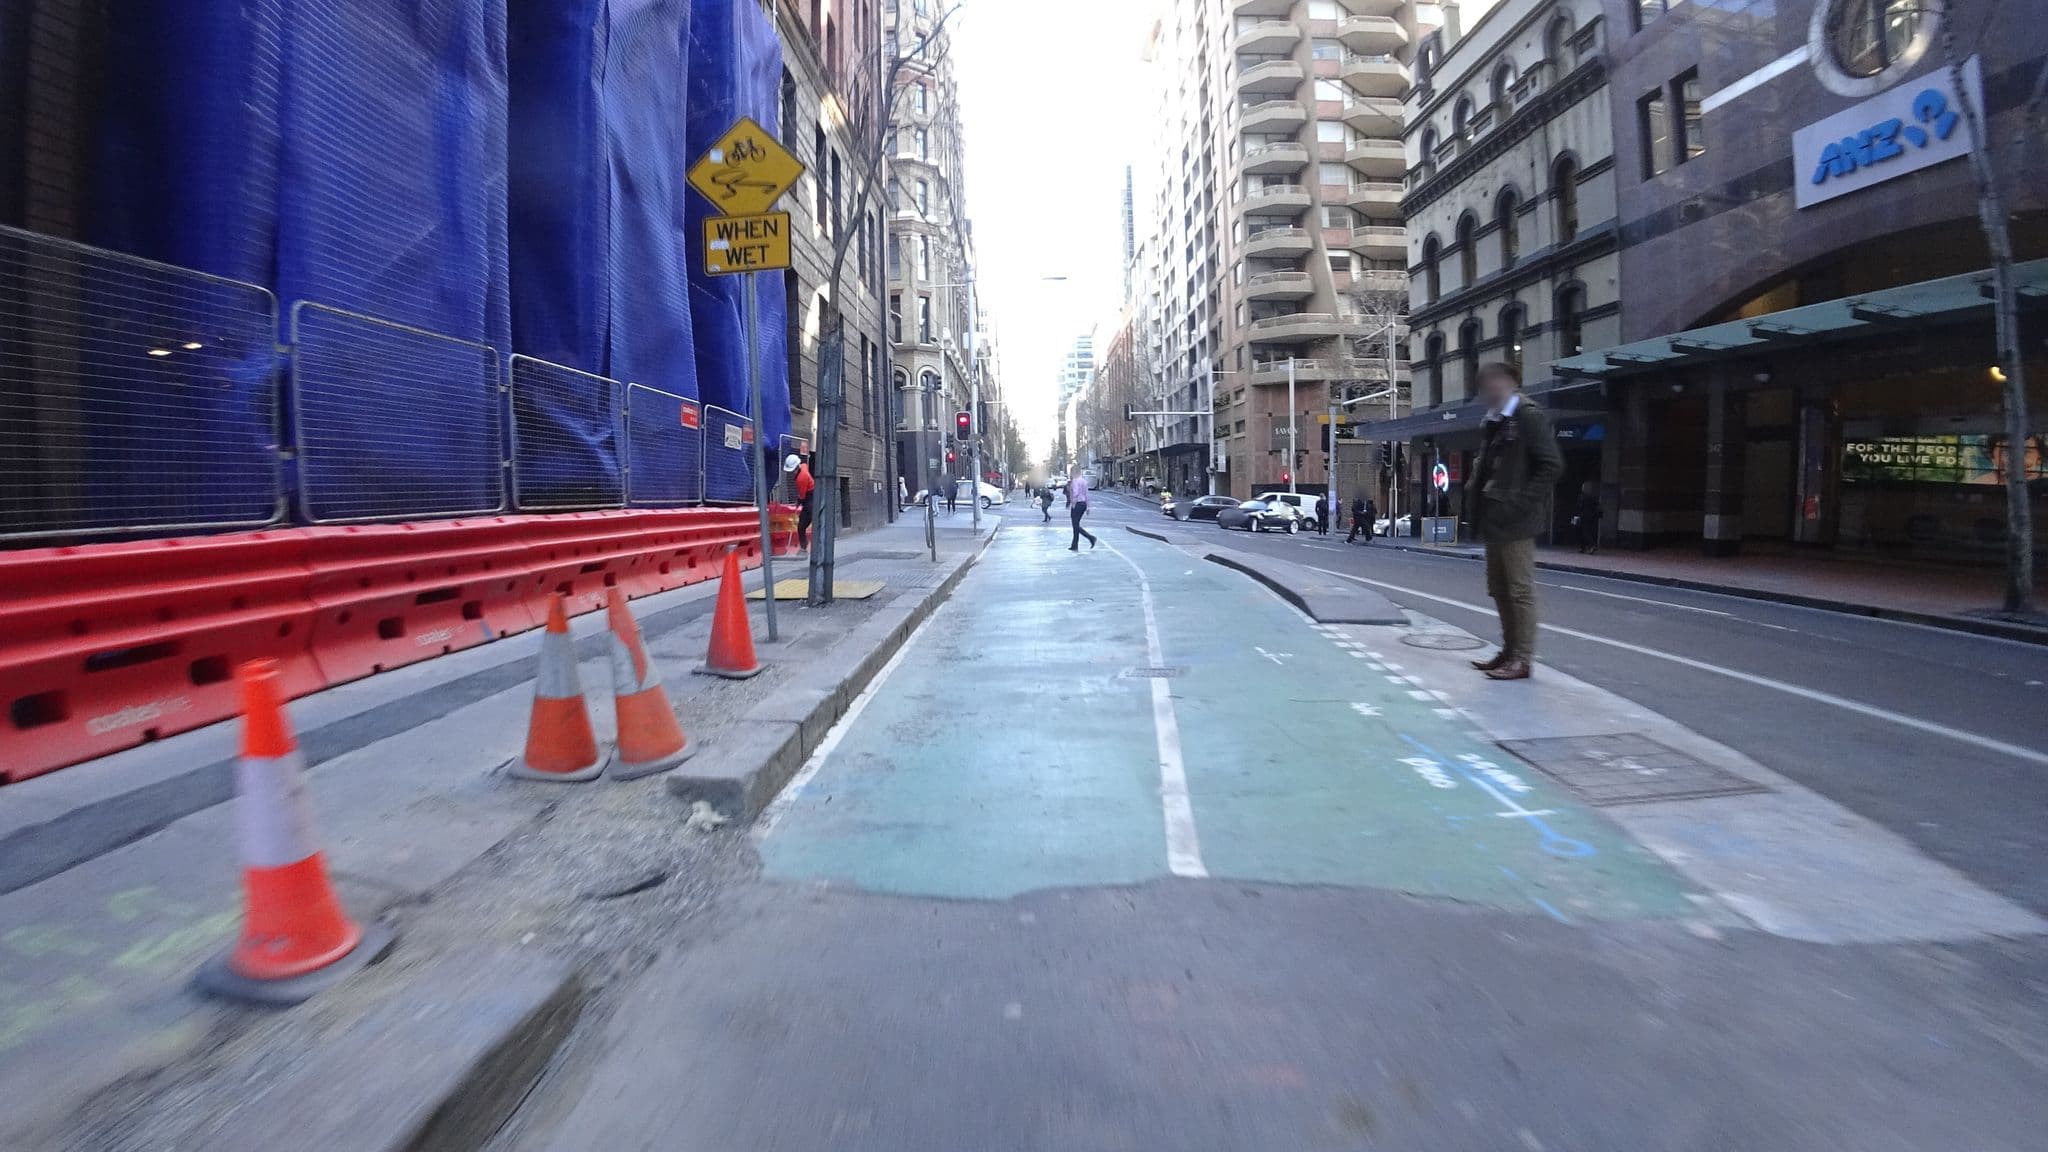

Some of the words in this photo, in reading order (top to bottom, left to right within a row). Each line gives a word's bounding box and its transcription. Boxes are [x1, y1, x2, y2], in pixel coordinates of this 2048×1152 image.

[1812, 118, 1904, 185] ANZ
[717, 219, 778, 240] WHEN
[725, 245, 769, 266] WET
[1847, 443, 1876, 452] FOR
[1881, 444, 1911, 453] THE
[1860, 453, 1891, 463] YOU
[1897, 454, 1930, 464] LIVE
